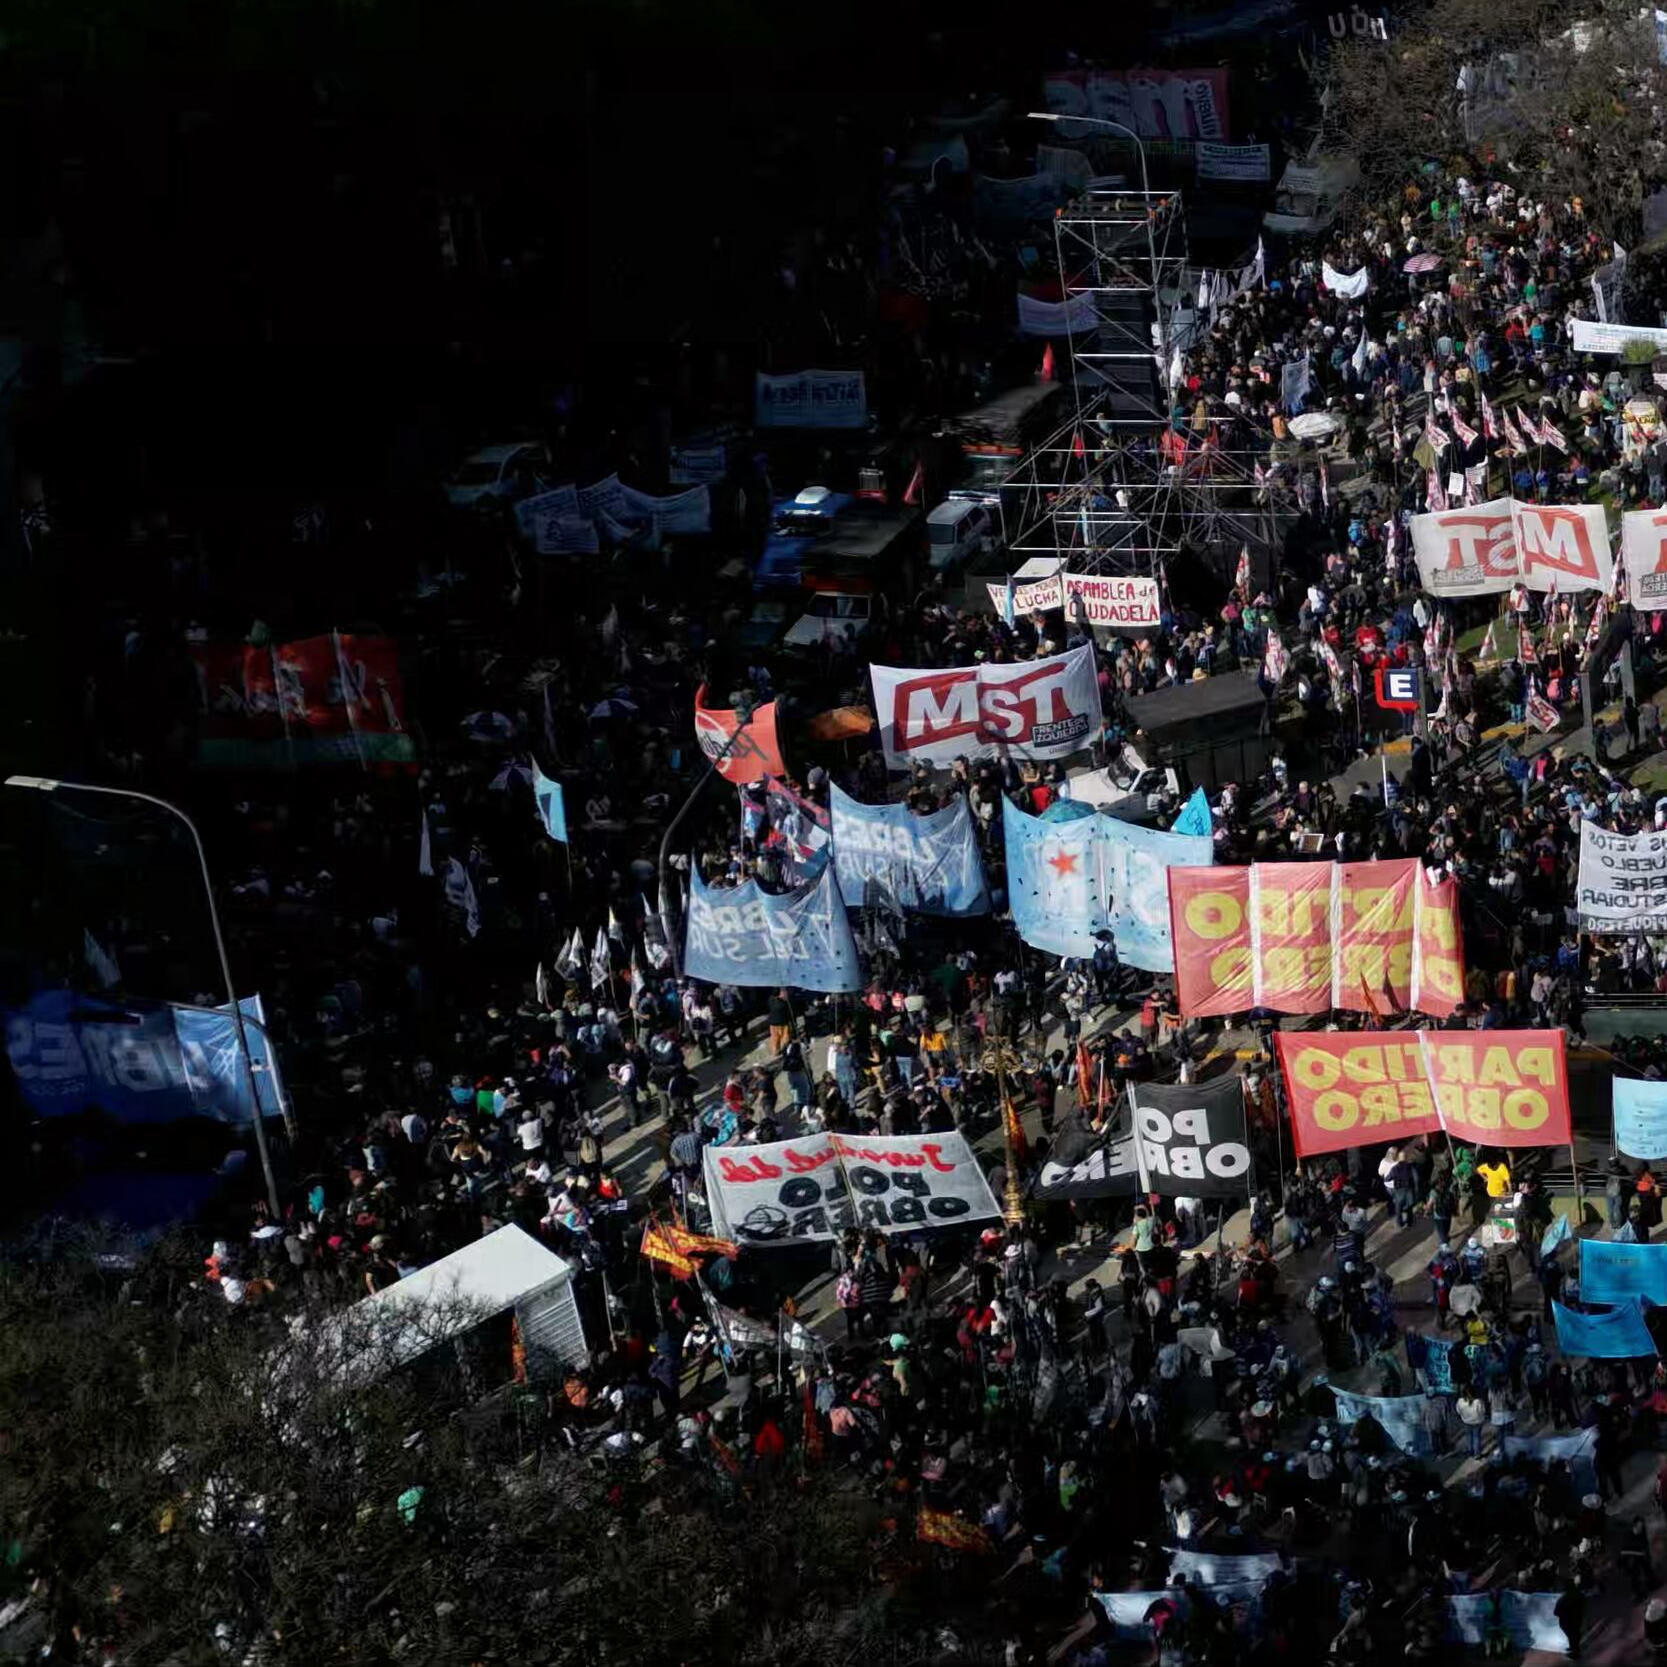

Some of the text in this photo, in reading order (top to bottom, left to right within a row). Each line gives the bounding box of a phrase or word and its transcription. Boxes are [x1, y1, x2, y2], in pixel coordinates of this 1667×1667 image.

[1015, 592, 1059, 610] LUCHA
[1066, 579, 1134, 601] ASAMBLEA
[1069, 605, 1159, 623] CUDADELA
[1390, 673, 1413, 698] E
[906, 686, 1066, 742] MST
